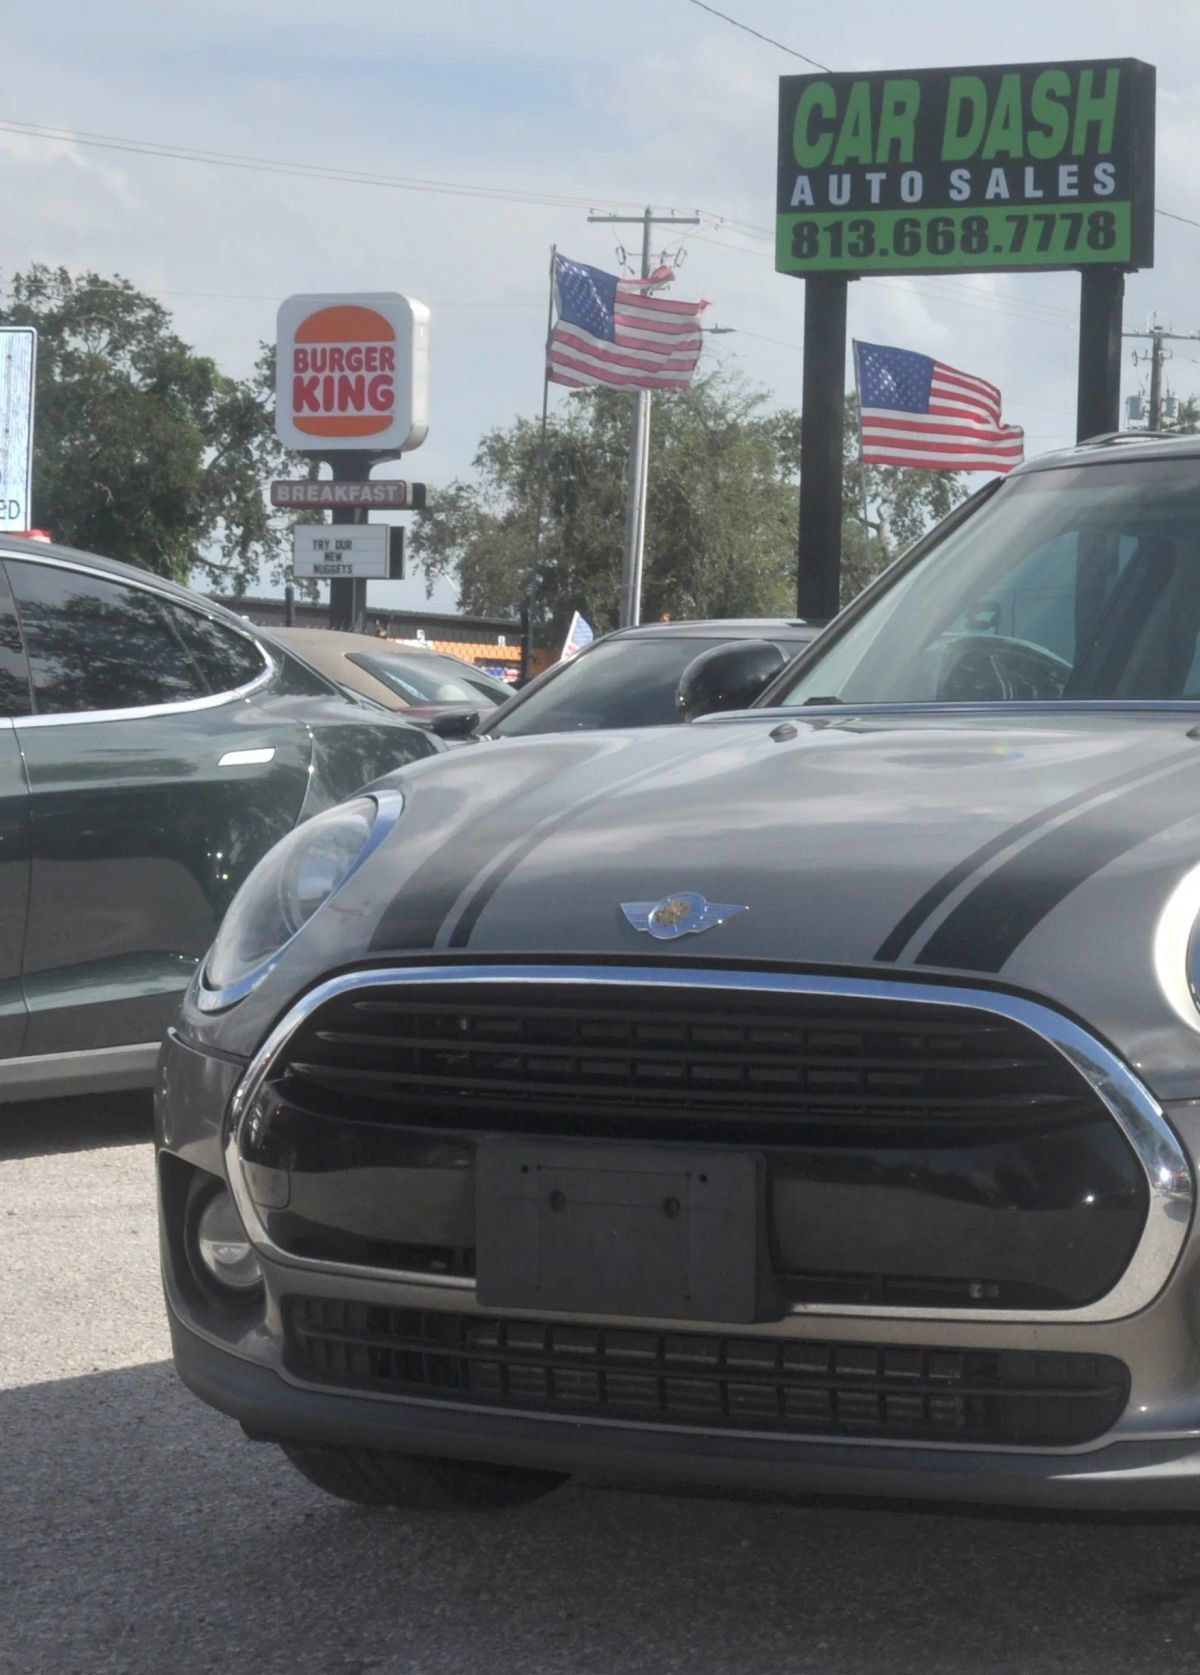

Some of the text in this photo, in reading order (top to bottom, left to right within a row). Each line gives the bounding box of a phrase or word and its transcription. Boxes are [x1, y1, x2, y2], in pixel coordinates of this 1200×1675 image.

[793, 67, 1120, 168] CAR DASH
[790, 162, 1116, 206] AUTO SALES
[791, 210, 1117, 260] 813.668.7778
[293, 346, 396, 373] BURGER
[292, 374, 395, 413] KING
[276, 484, 397, 502] BREAKFAST
[312, 539, 352, 550] TRY OUR
[324, 551, 342, 561] NEW
[312, 564, 353, 575] NUGGETS
